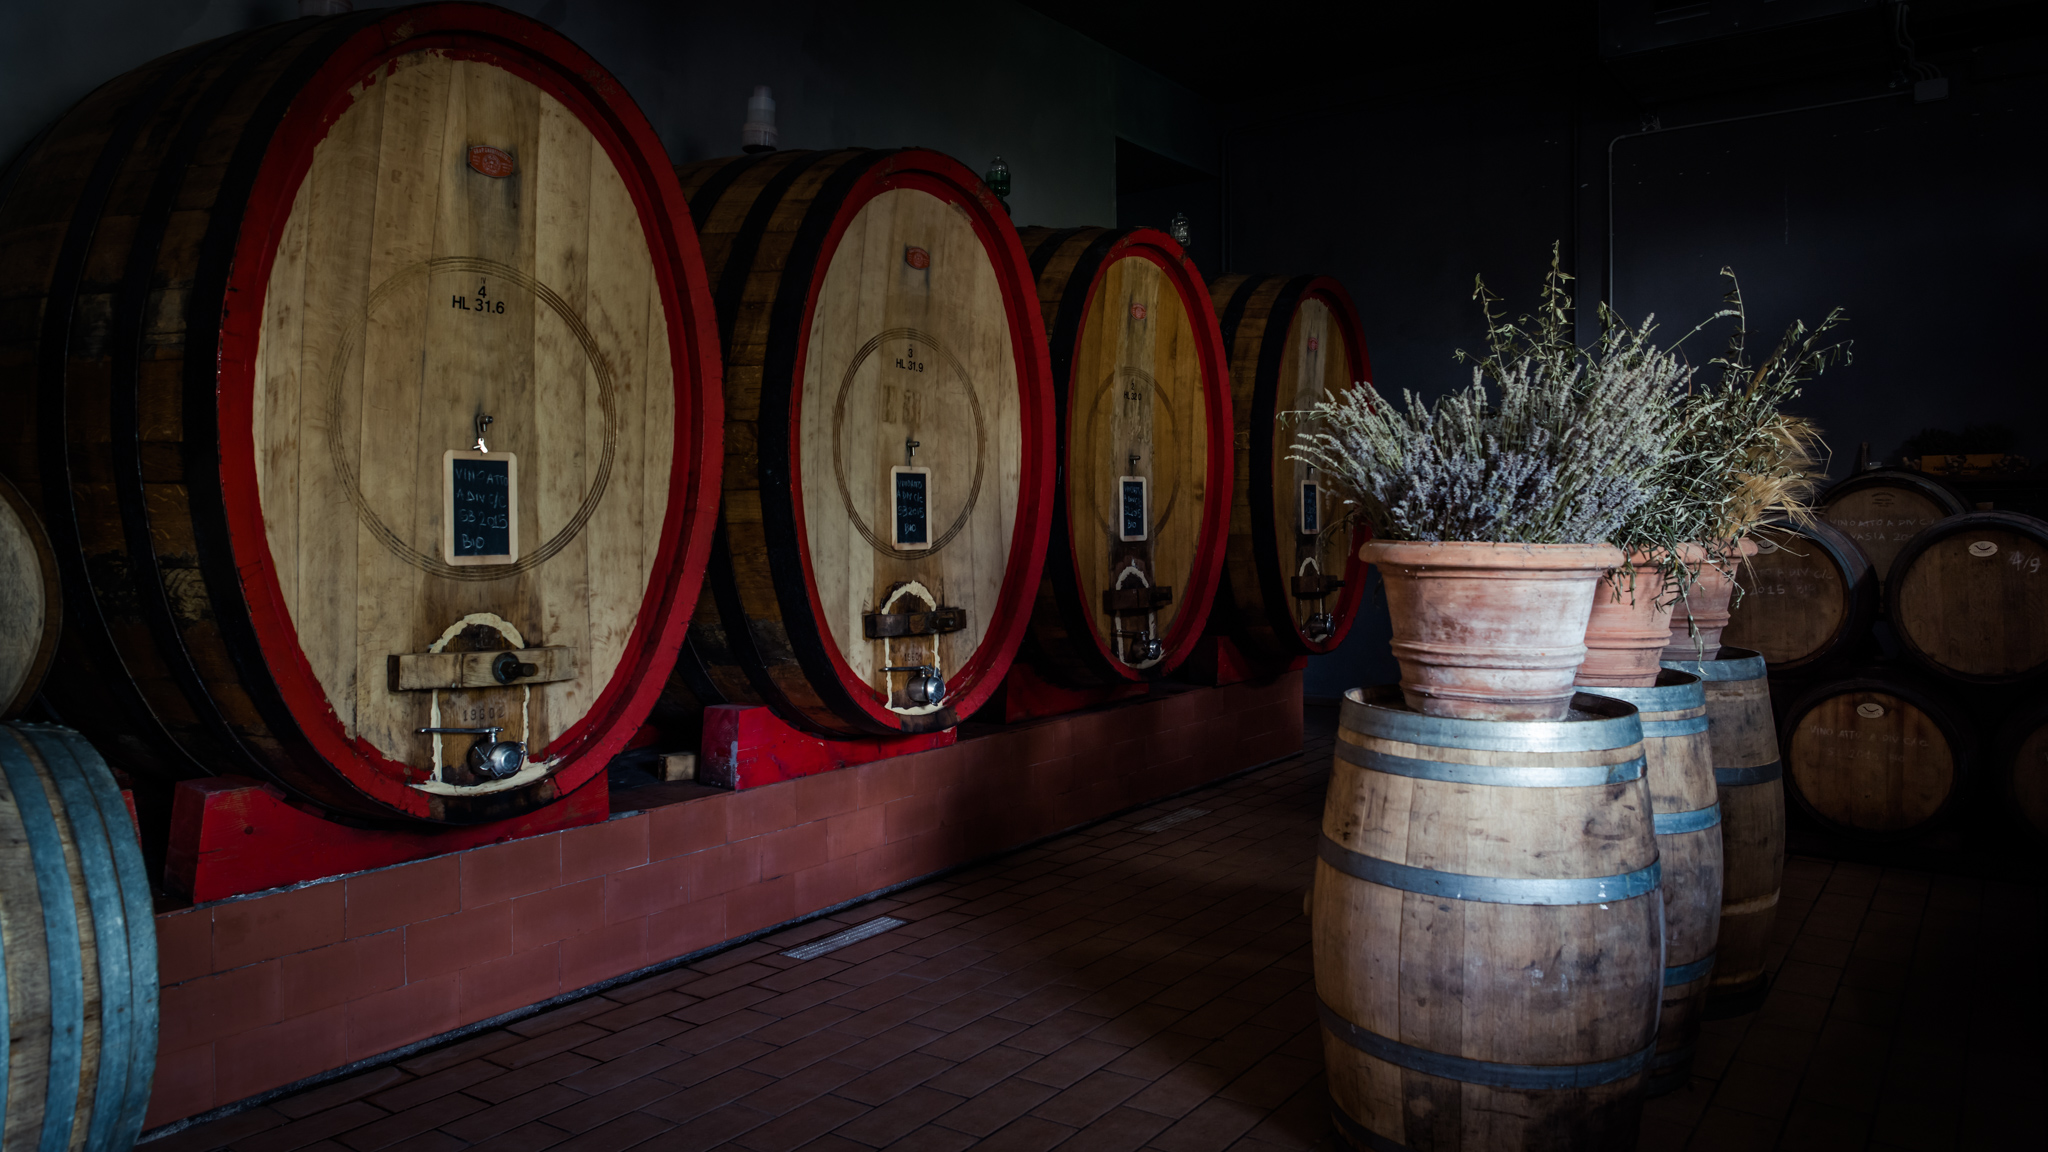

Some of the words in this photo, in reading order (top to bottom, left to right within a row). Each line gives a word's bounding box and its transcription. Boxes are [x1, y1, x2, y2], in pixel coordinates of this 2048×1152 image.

[478, 285, 486, 298] 4
[452, 295, 470, 310] HL
[475, 298, 504, 314] 31.6
[907, 348, 913, 358] 3
[896, 358, 906, 369] HL
[907, 360, 923, 373] 31.9
